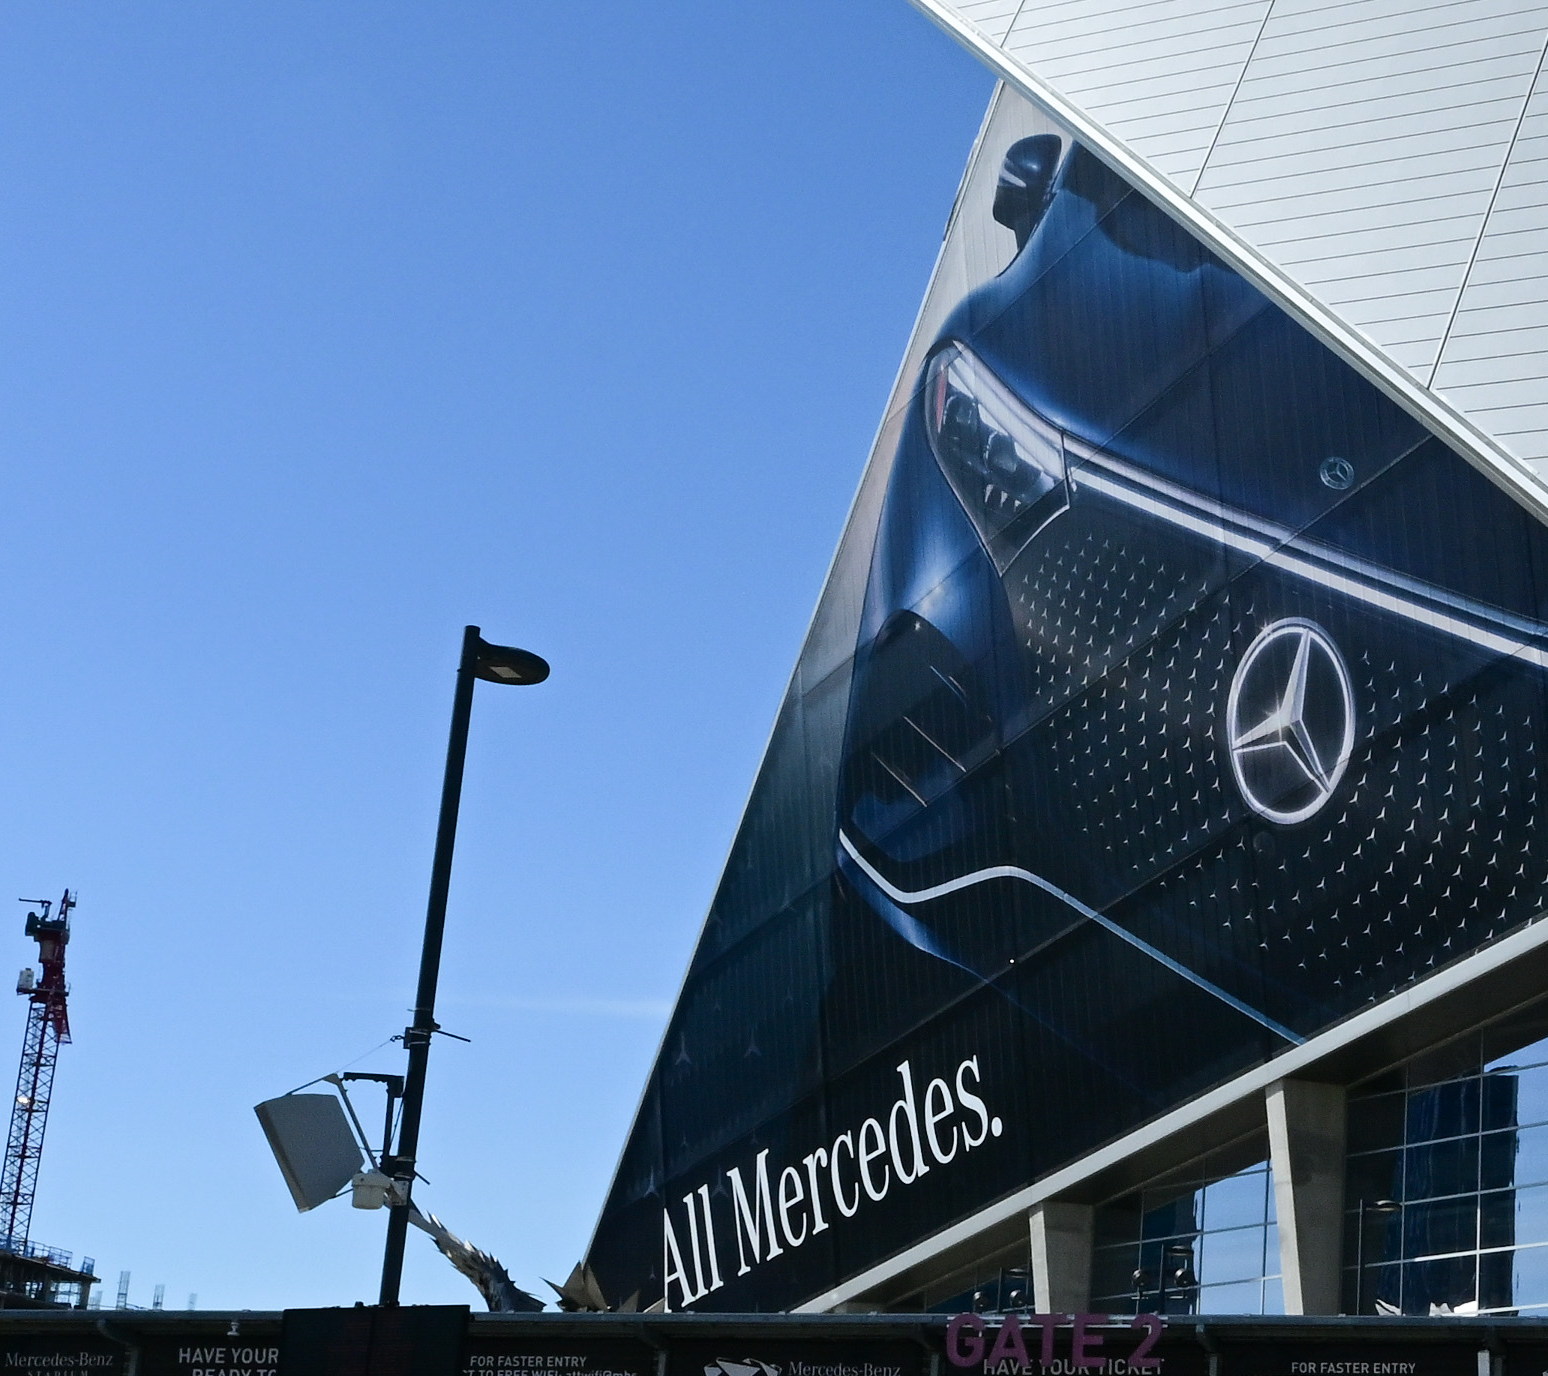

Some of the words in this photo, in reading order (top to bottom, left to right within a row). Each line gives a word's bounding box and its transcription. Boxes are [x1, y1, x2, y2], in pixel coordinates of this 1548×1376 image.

[663, 1184, 724, 1314] All
[726, 1054, 1003, 1278] Mercedes.
[946, 1313, 1107, 1367] GATE
[1128, 1313, 1164, 1367] 2
[5, 1352, 113, 1367] Mercedes-Benz
[178, 1347, 226, 1364] HAVE
[231, 1347, 279, 1364] YOUR
[470, 1356, 494, 1367] FOR
[497, 1356, 543, 1367] FASTER
[546, 1356, 587, 1367] ENTRY
[1291, 1362, 1317, 1374] FOR
[1320, 1362, 1370, 1374] FASTER
[1373, 1362, 1416, 1374] ENTRY
